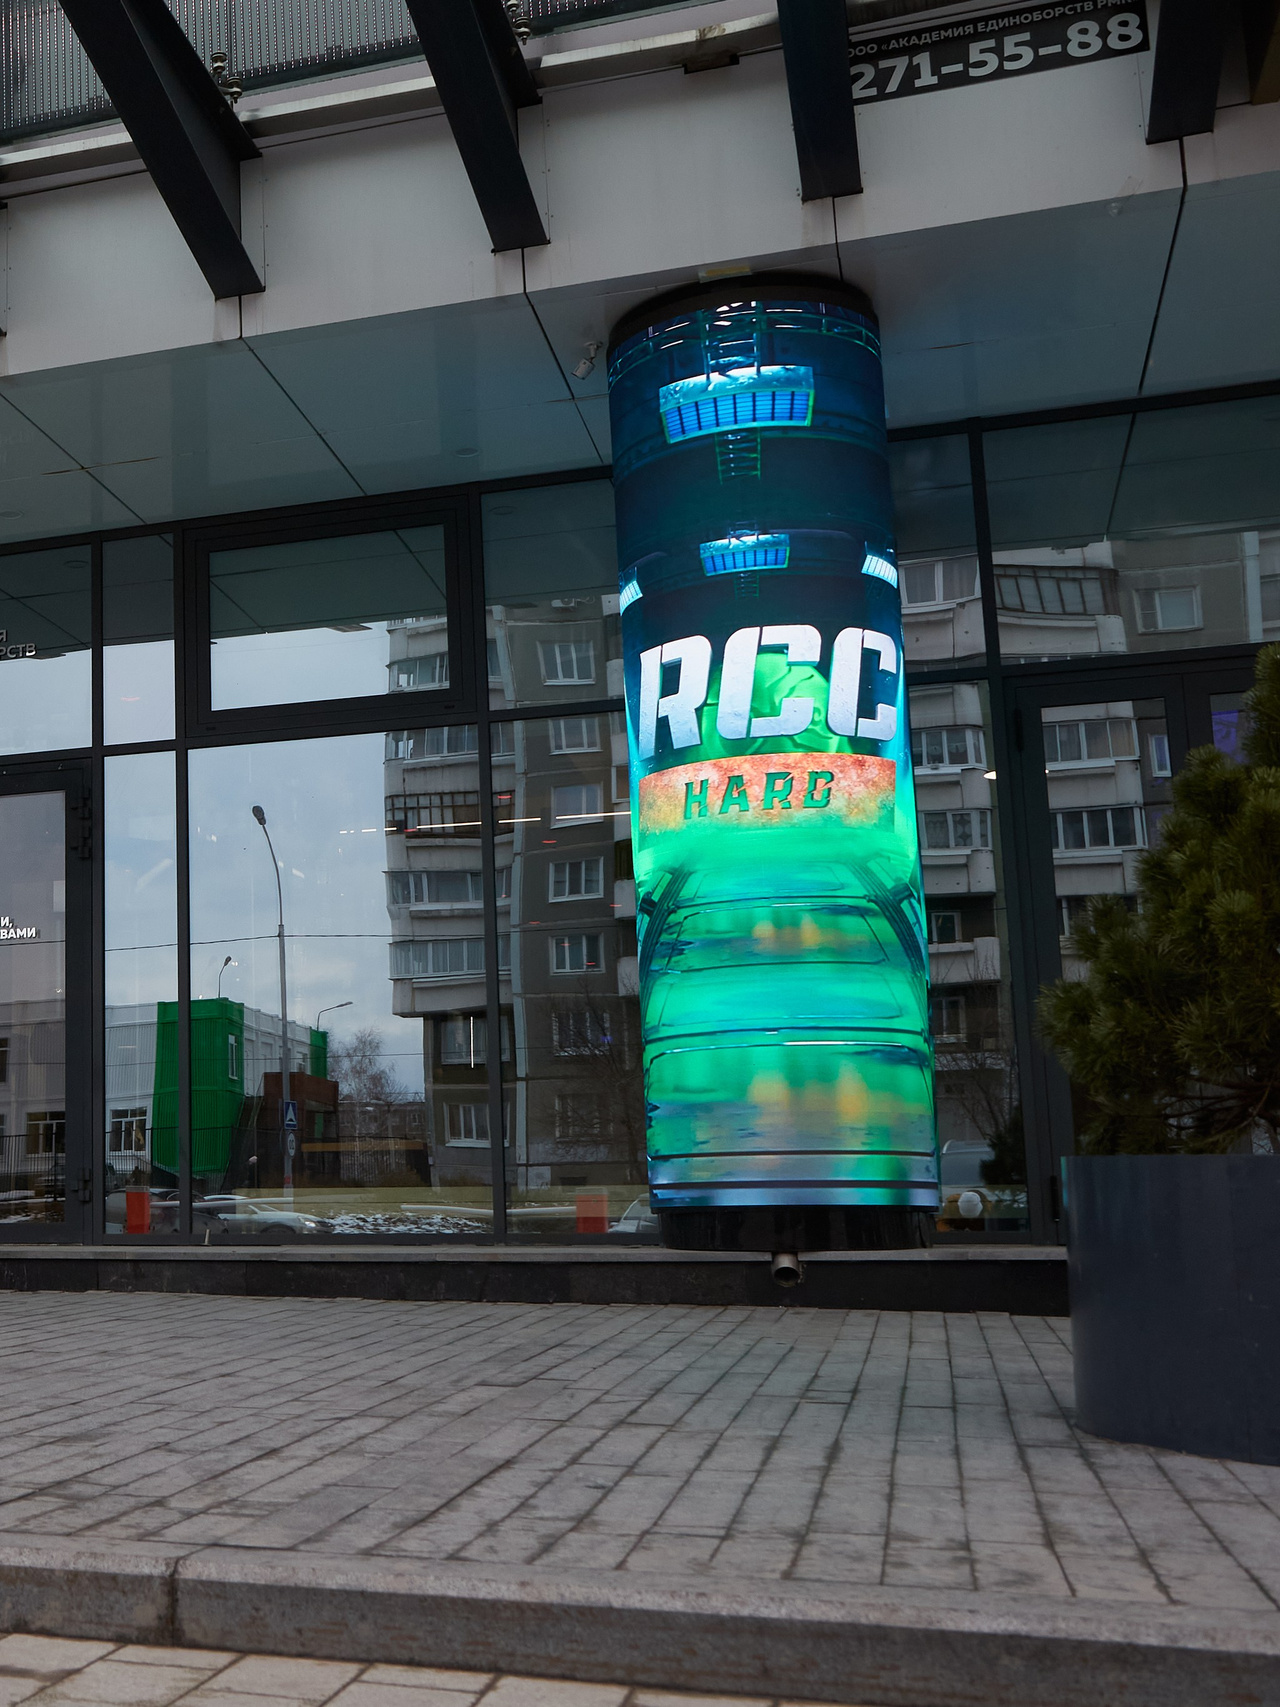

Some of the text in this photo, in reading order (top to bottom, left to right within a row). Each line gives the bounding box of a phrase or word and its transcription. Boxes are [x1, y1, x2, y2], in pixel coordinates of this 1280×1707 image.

[977, 1, 1094, 33] ЕДИНОБОРСТВ
[849, 12, 1144, 99] 271-55-88
[638, 624, 897, 761] RCC
[683, 770, 835, 820] HARD
